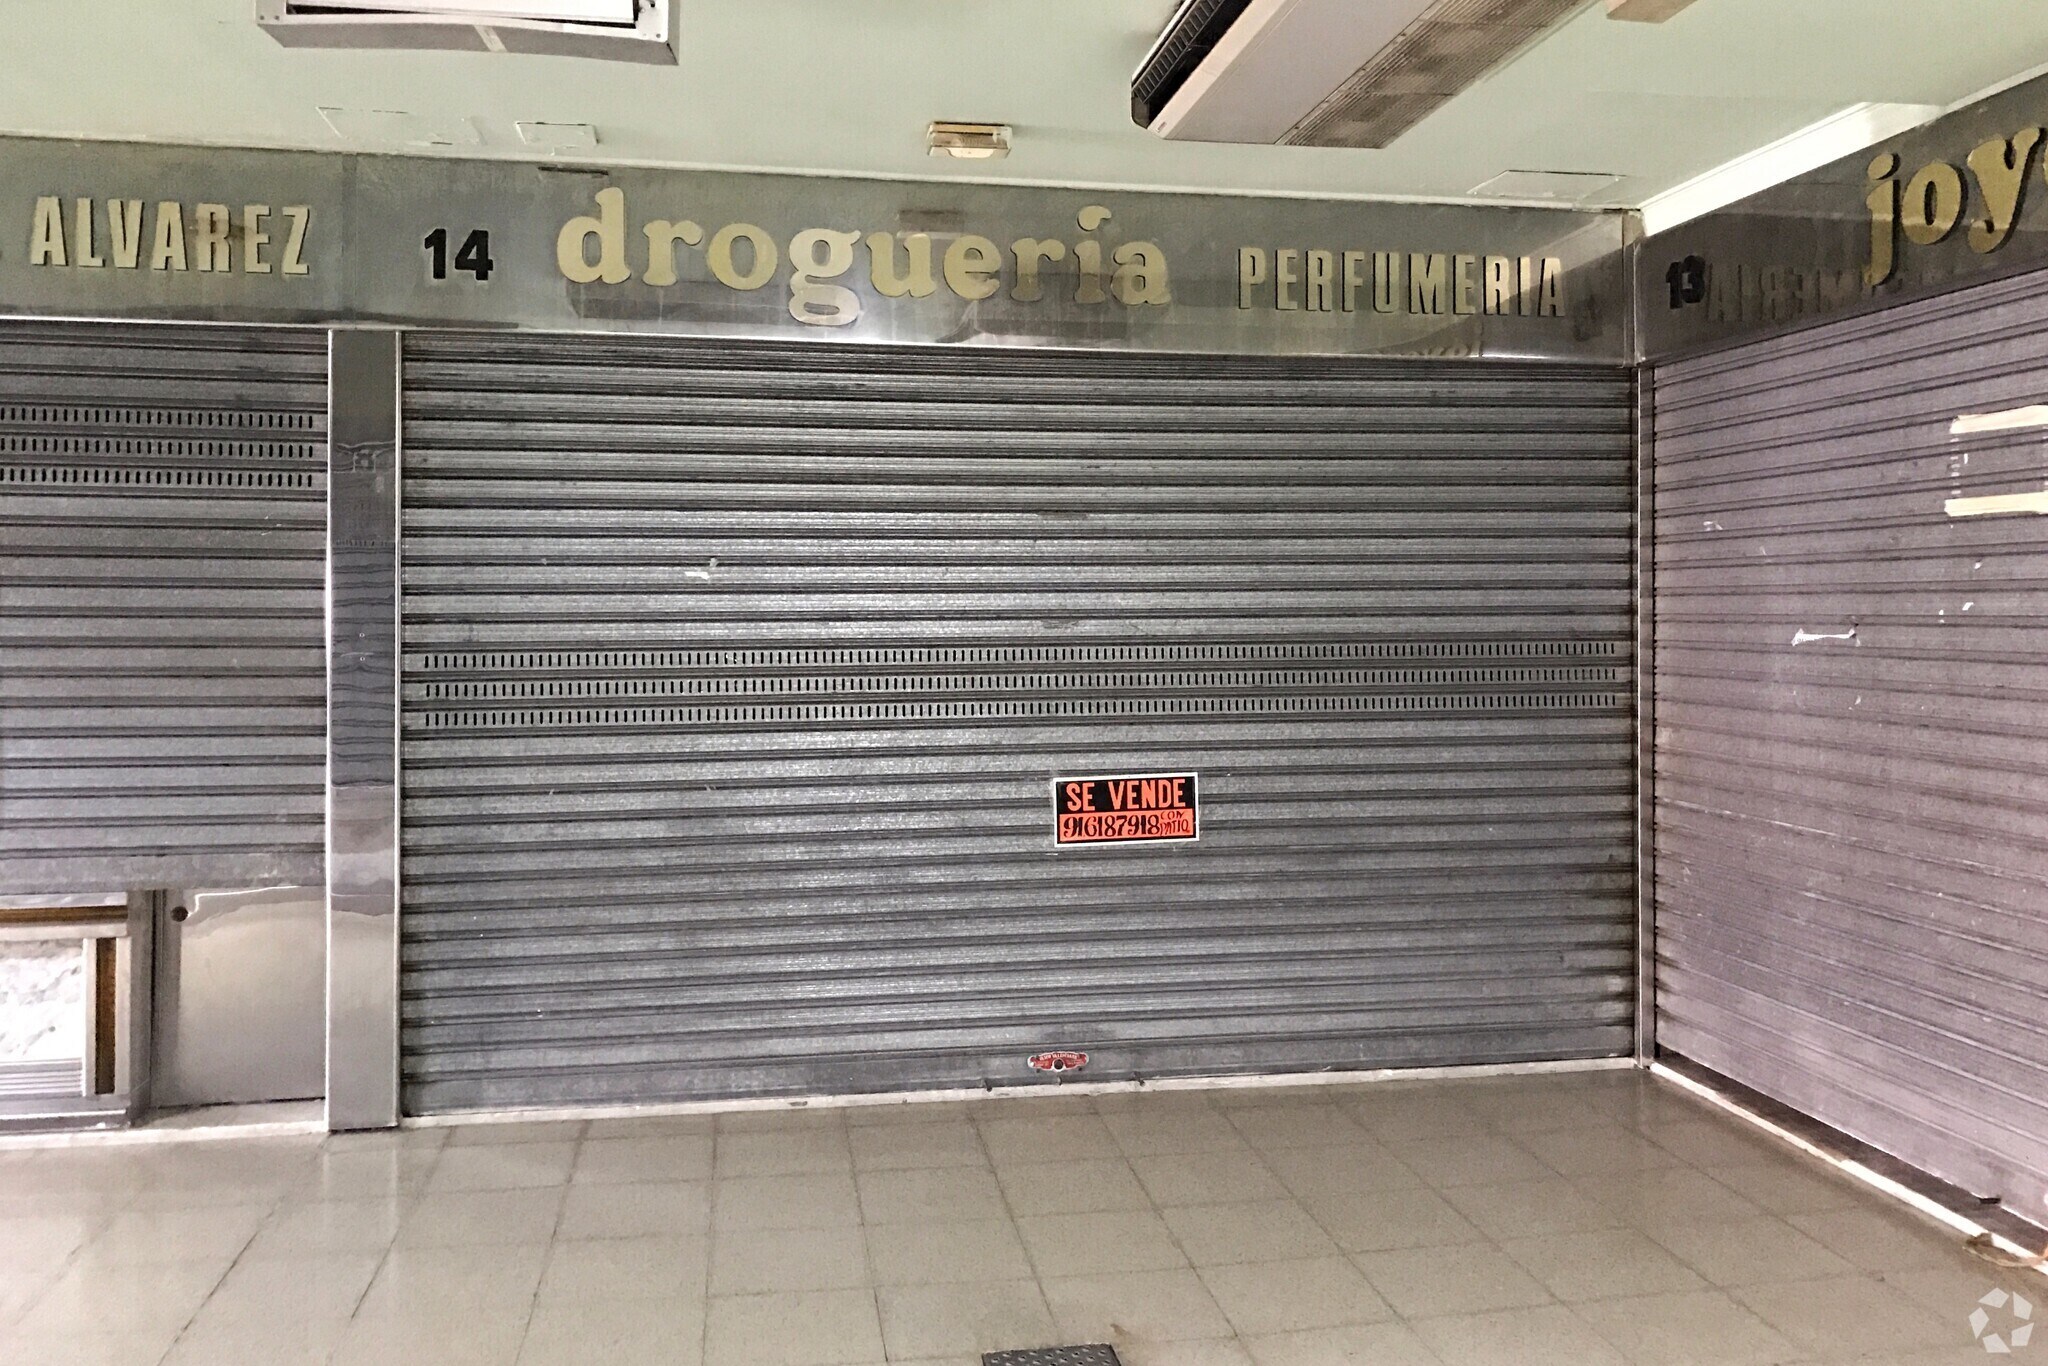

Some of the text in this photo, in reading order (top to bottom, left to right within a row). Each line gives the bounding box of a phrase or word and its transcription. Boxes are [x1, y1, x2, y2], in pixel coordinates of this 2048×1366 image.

[31, 196, 311, 276] ALVAREZ
[1862, 127, 2048, 287] joy
[424, 228, 494, 281] 14
[1238, 247, 1566, 317] PERFUMERIA
[1665, 255, 1706, 310] 13
[1066, 779, 1186, 812] SE VENDE
